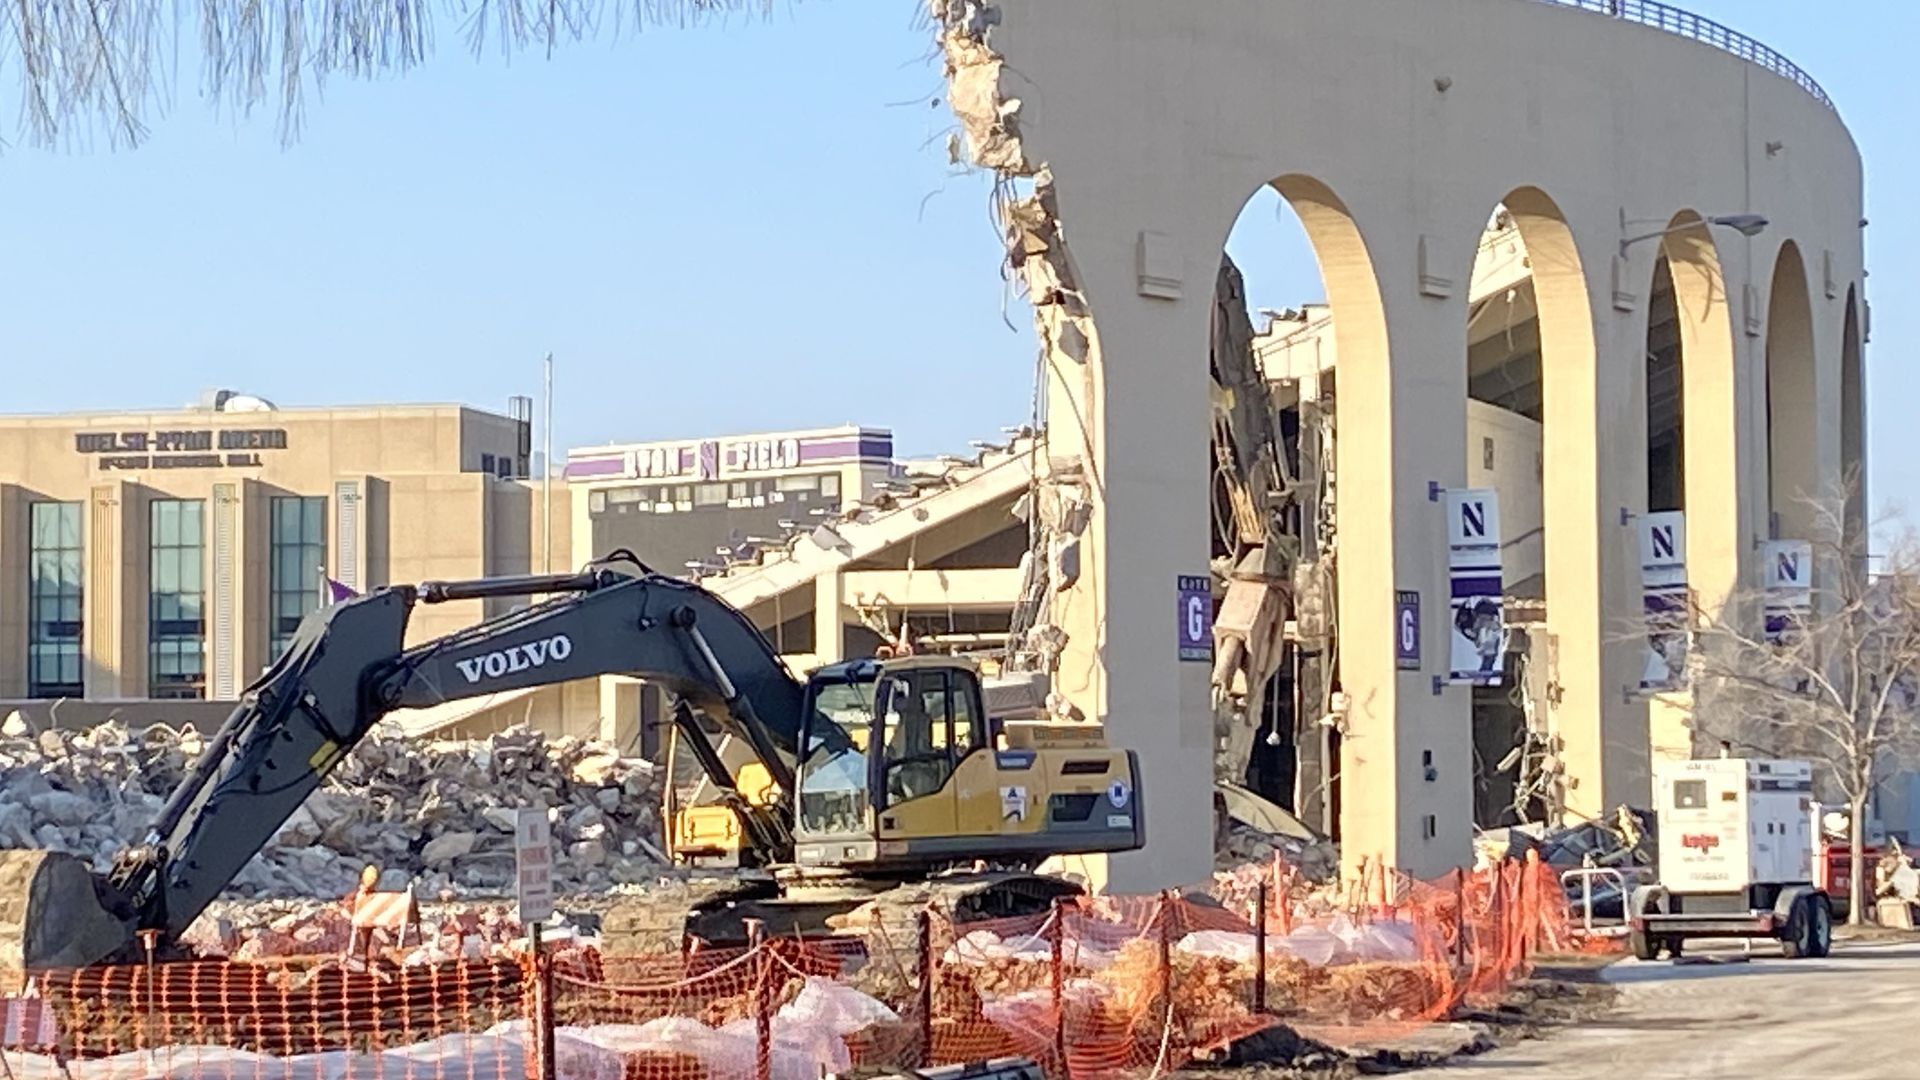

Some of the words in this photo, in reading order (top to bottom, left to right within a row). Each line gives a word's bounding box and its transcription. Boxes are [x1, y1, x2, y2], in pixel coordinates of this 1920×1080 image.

[736, 438, 800, 472] FIELD
[1461, 502, 1485, 537] N
[1651, 525, 1674, 558] N
[1777, 551, 1798, 581] N
[1188, 596, 1203, 641] G
[1402, 609, 1414, 651] G
[456, 635, 571, 683] VOLVO
